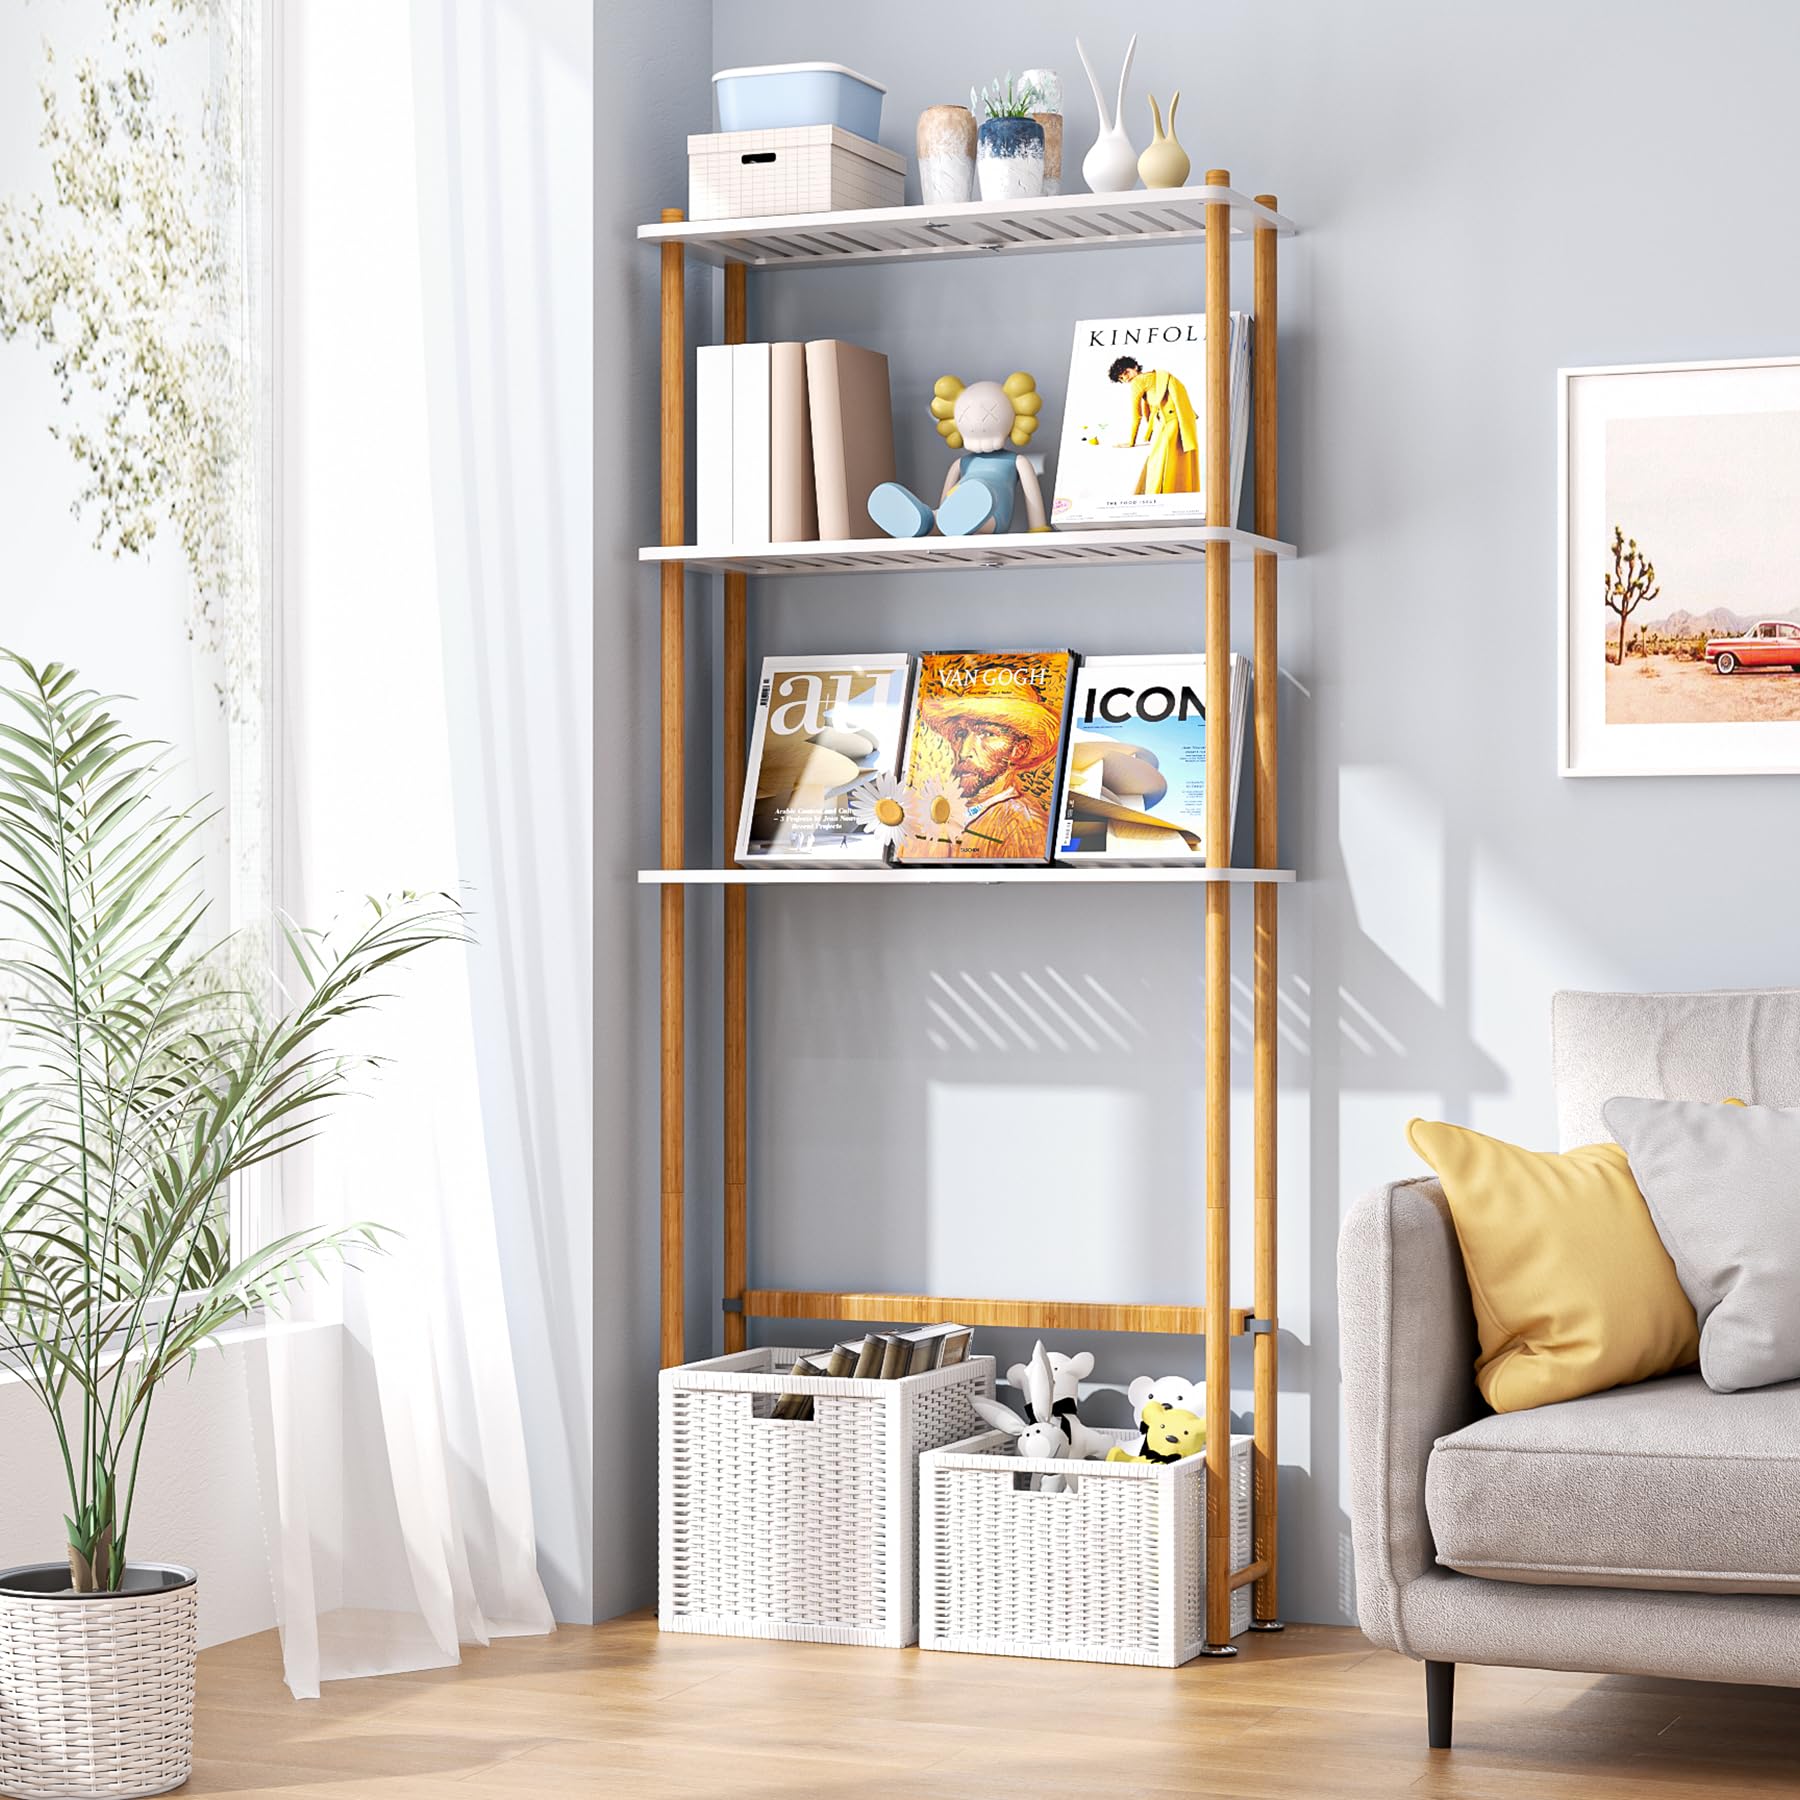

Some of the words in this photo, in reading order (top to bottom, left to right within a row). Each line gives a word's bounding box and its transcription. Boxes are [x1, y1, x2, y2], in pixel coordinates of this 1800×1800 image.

[1089, 325, 1207, 347] KINFOL
[939, 668, 979, 687] VAN
[982, 668, 1046, 686] GOGH
[1084, 686, 1206, 723] ICON
